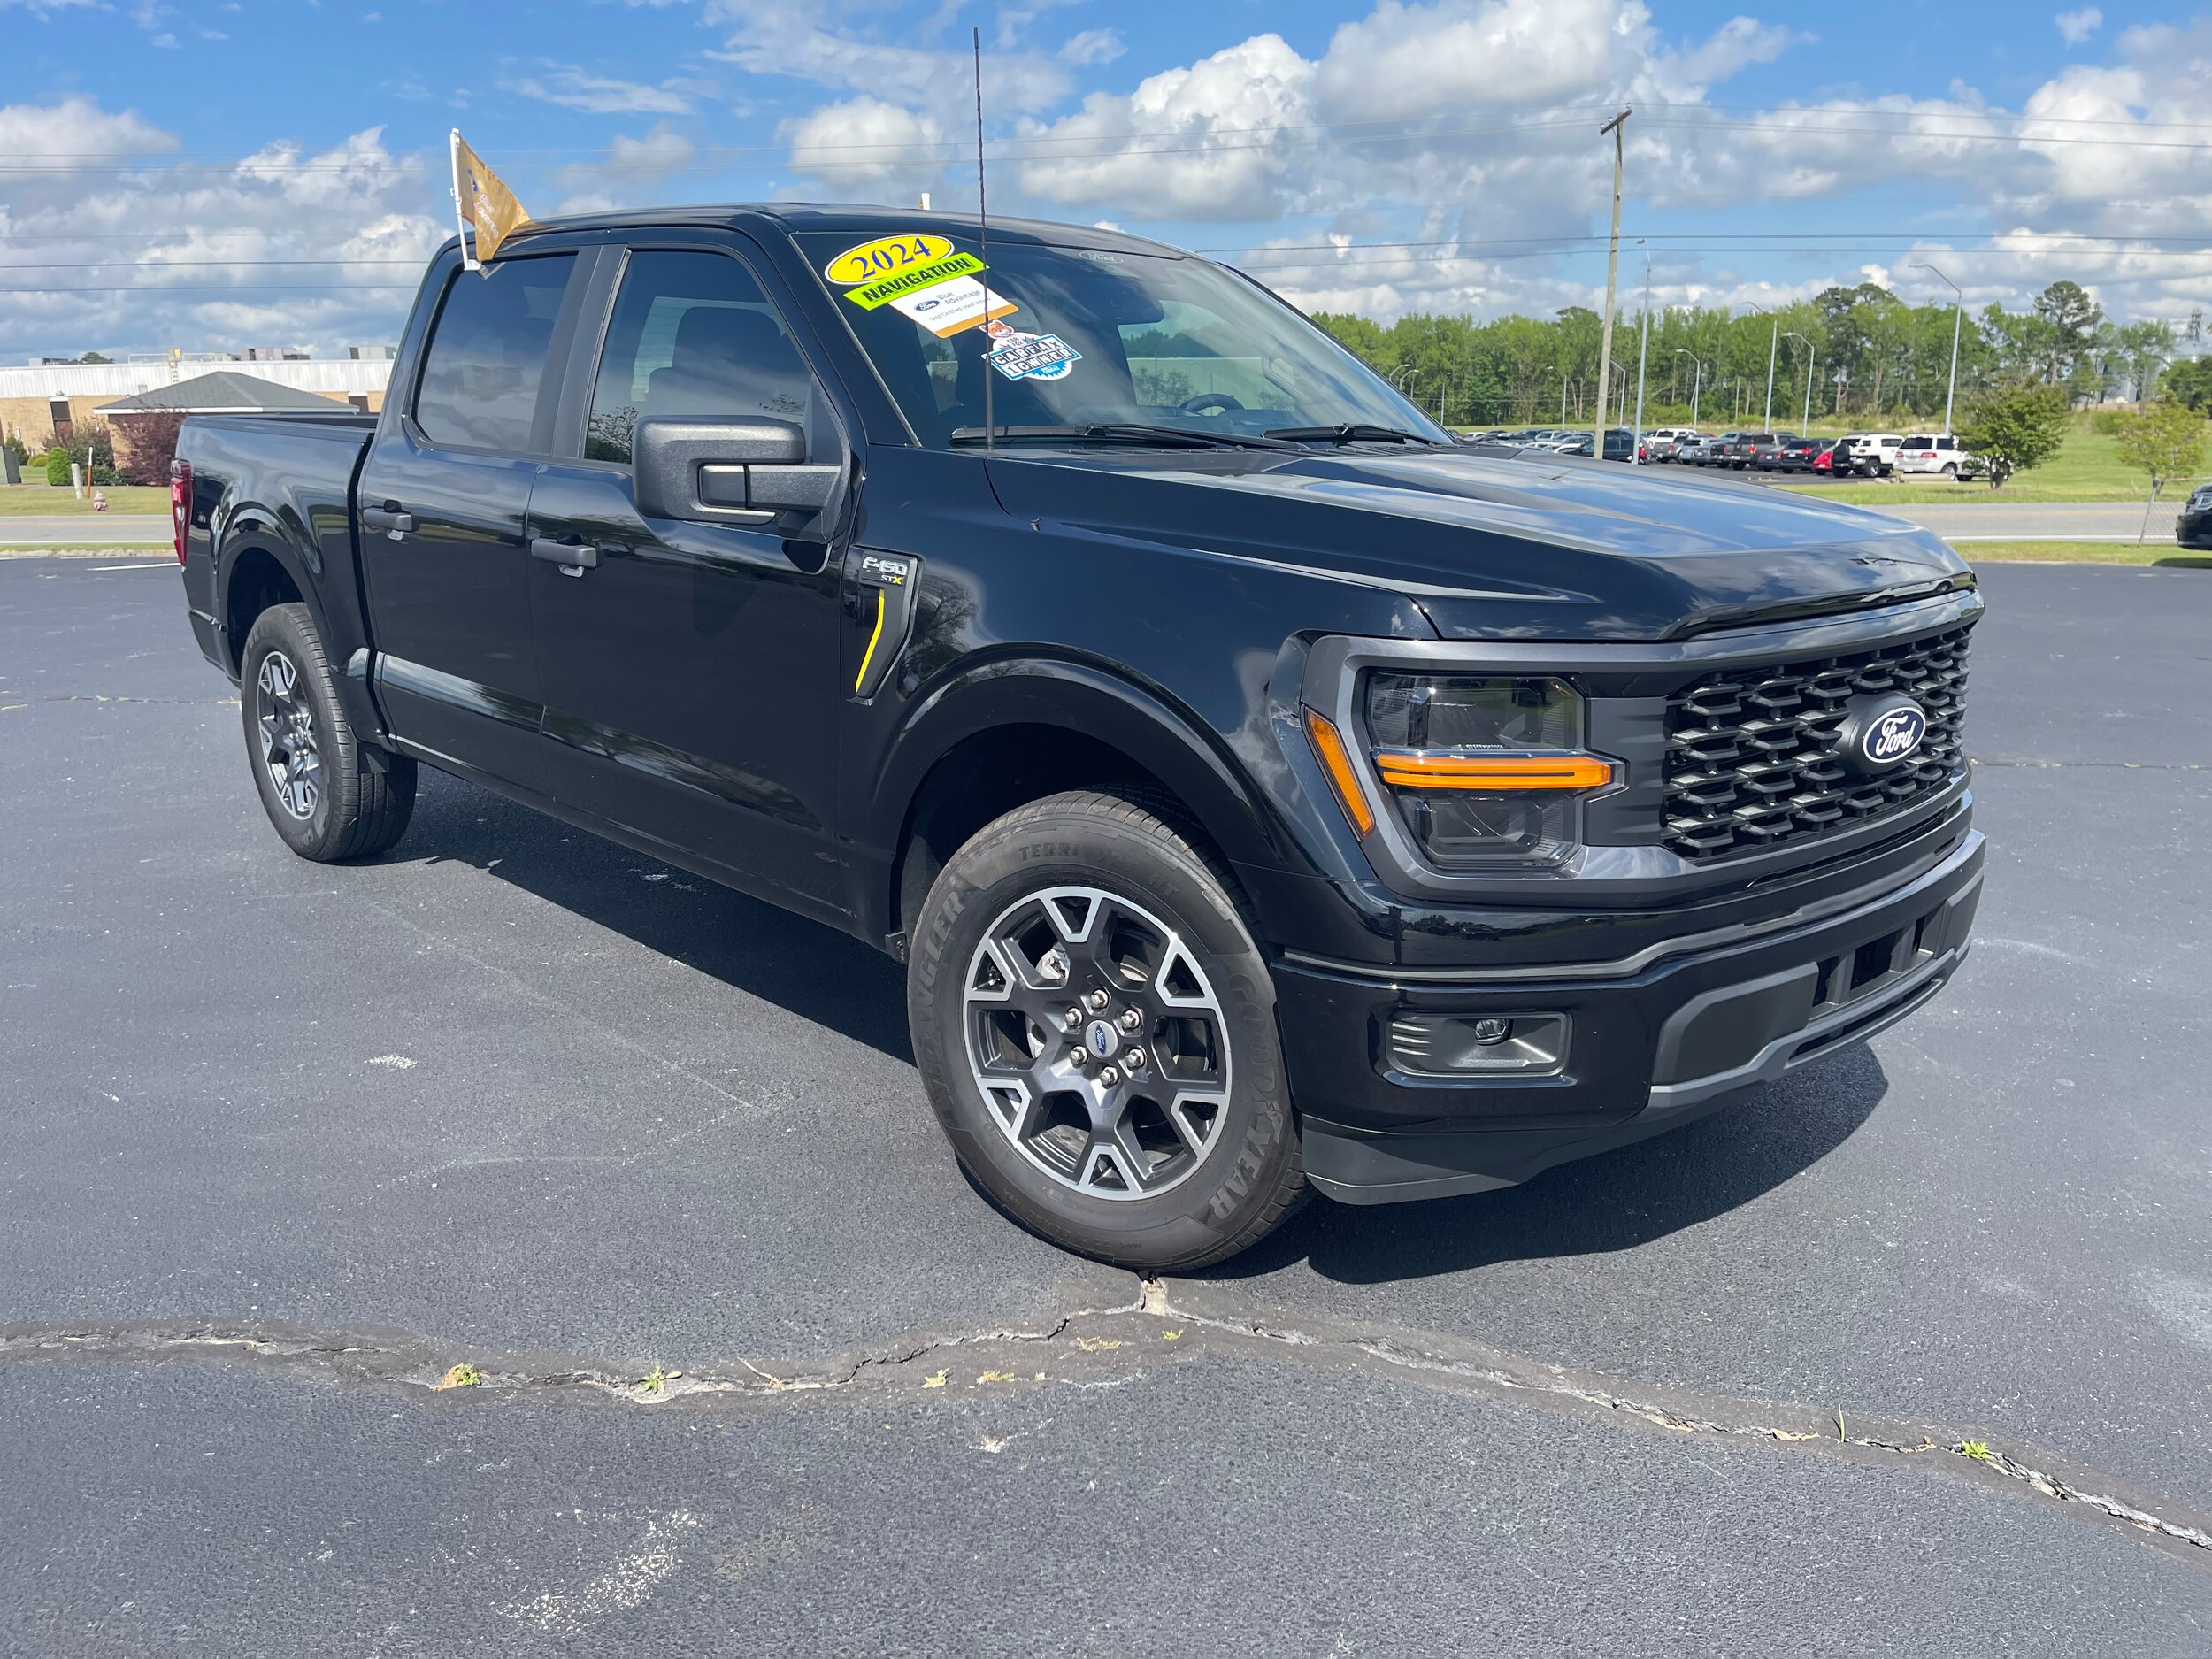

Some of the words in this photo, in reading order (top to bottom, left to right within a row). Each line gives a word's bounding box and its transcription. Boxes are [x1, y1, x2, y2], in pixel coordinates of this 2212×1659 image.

[851, 237, 931, 280] 2024
[862, 257, 973, 303] NAVIGATION
[936, 291, 955, 300] Blue
[945, 290, 981, 305] Advantage
[993, 341, 1062, 365] CARFAX
[1018, 349, 1073, 370] OWNER
[862, 557, 908, 576] F-150
[881, 574, 902, 585] STX
[1876, 715, 1916, 756] Ford
